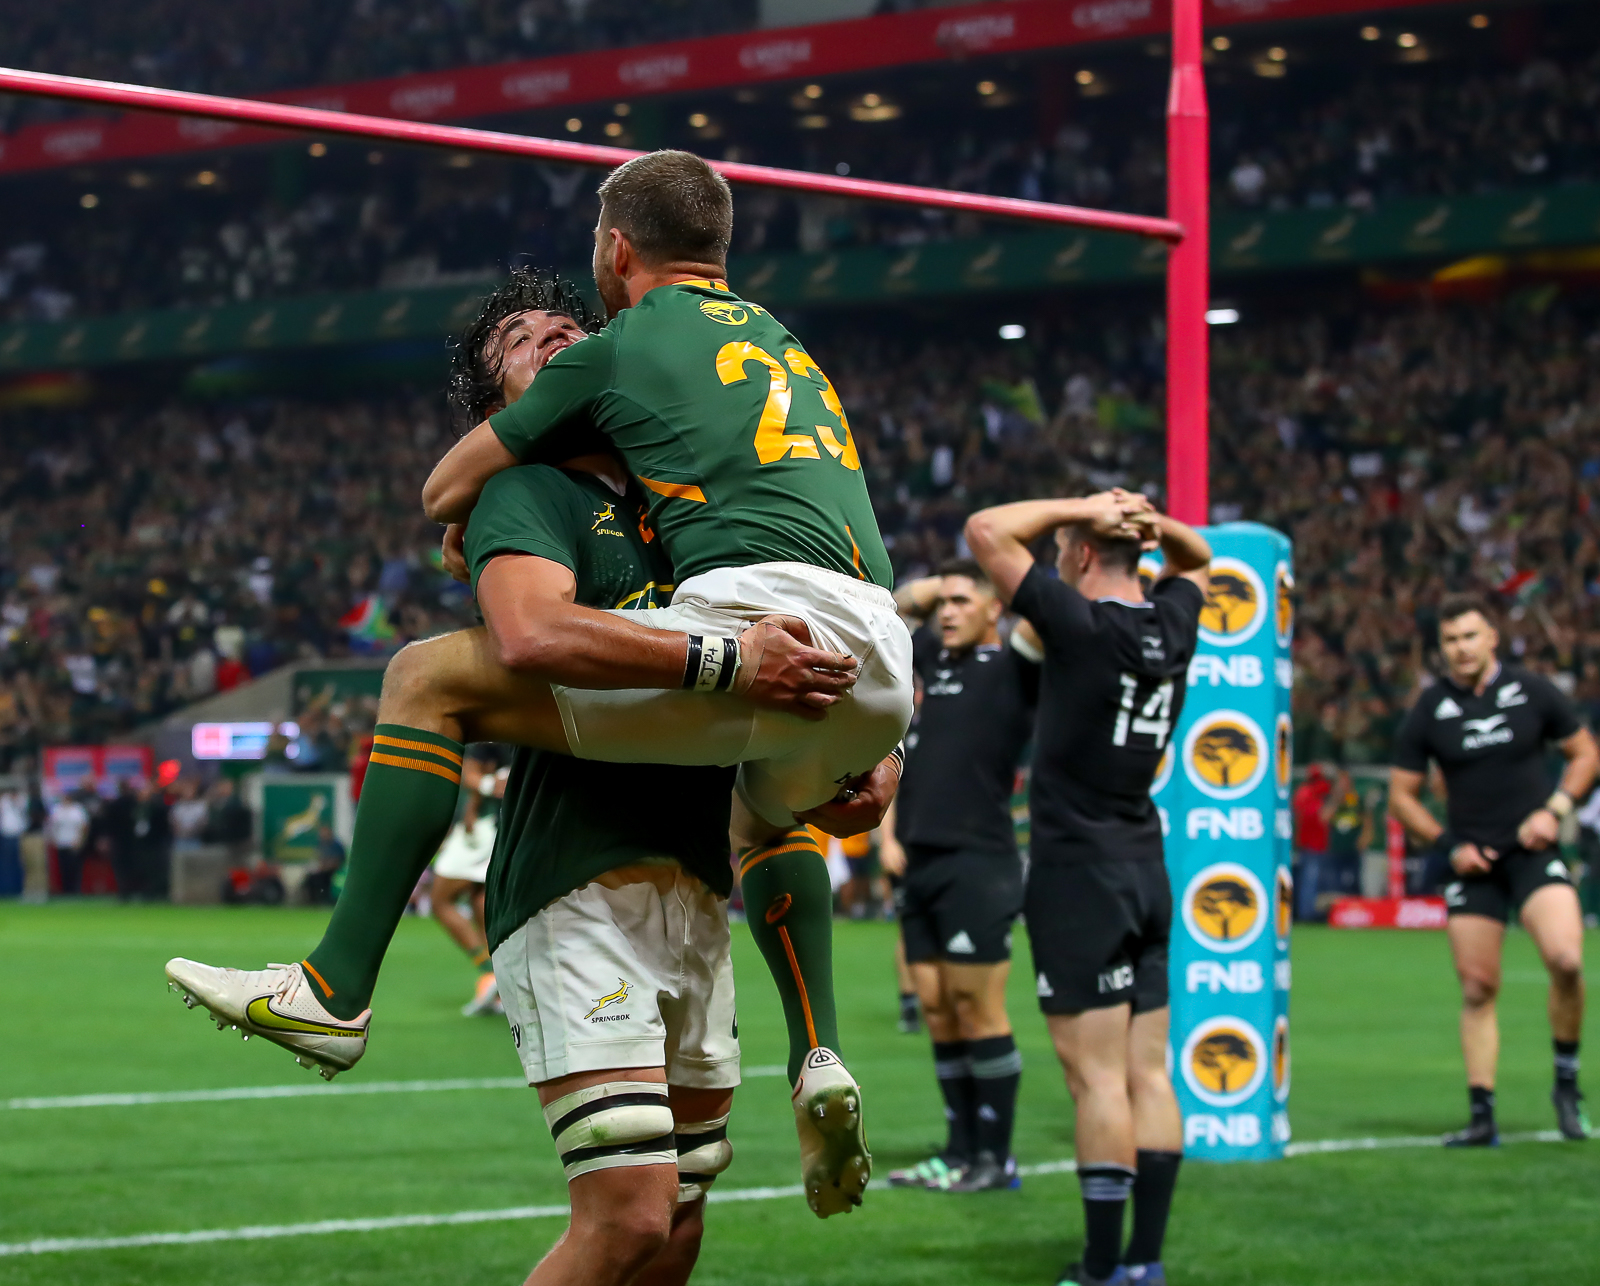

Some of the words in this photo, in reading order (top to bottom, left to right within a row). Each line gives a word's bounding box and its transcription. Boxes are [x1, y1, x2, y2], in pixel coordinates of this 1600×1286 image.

[715, 341, 860, 470] 23
[1186, 654, 1264, 687] FNB
[1112, 673, 1174, 749] 14
[1186, 807, 1264, 840] FNB
[1186, 959, 1264, 993] FNB
[591, 1014, 630, 1023] SPRINGBOK
[1184, 1113, 1262, 1147] FNB
